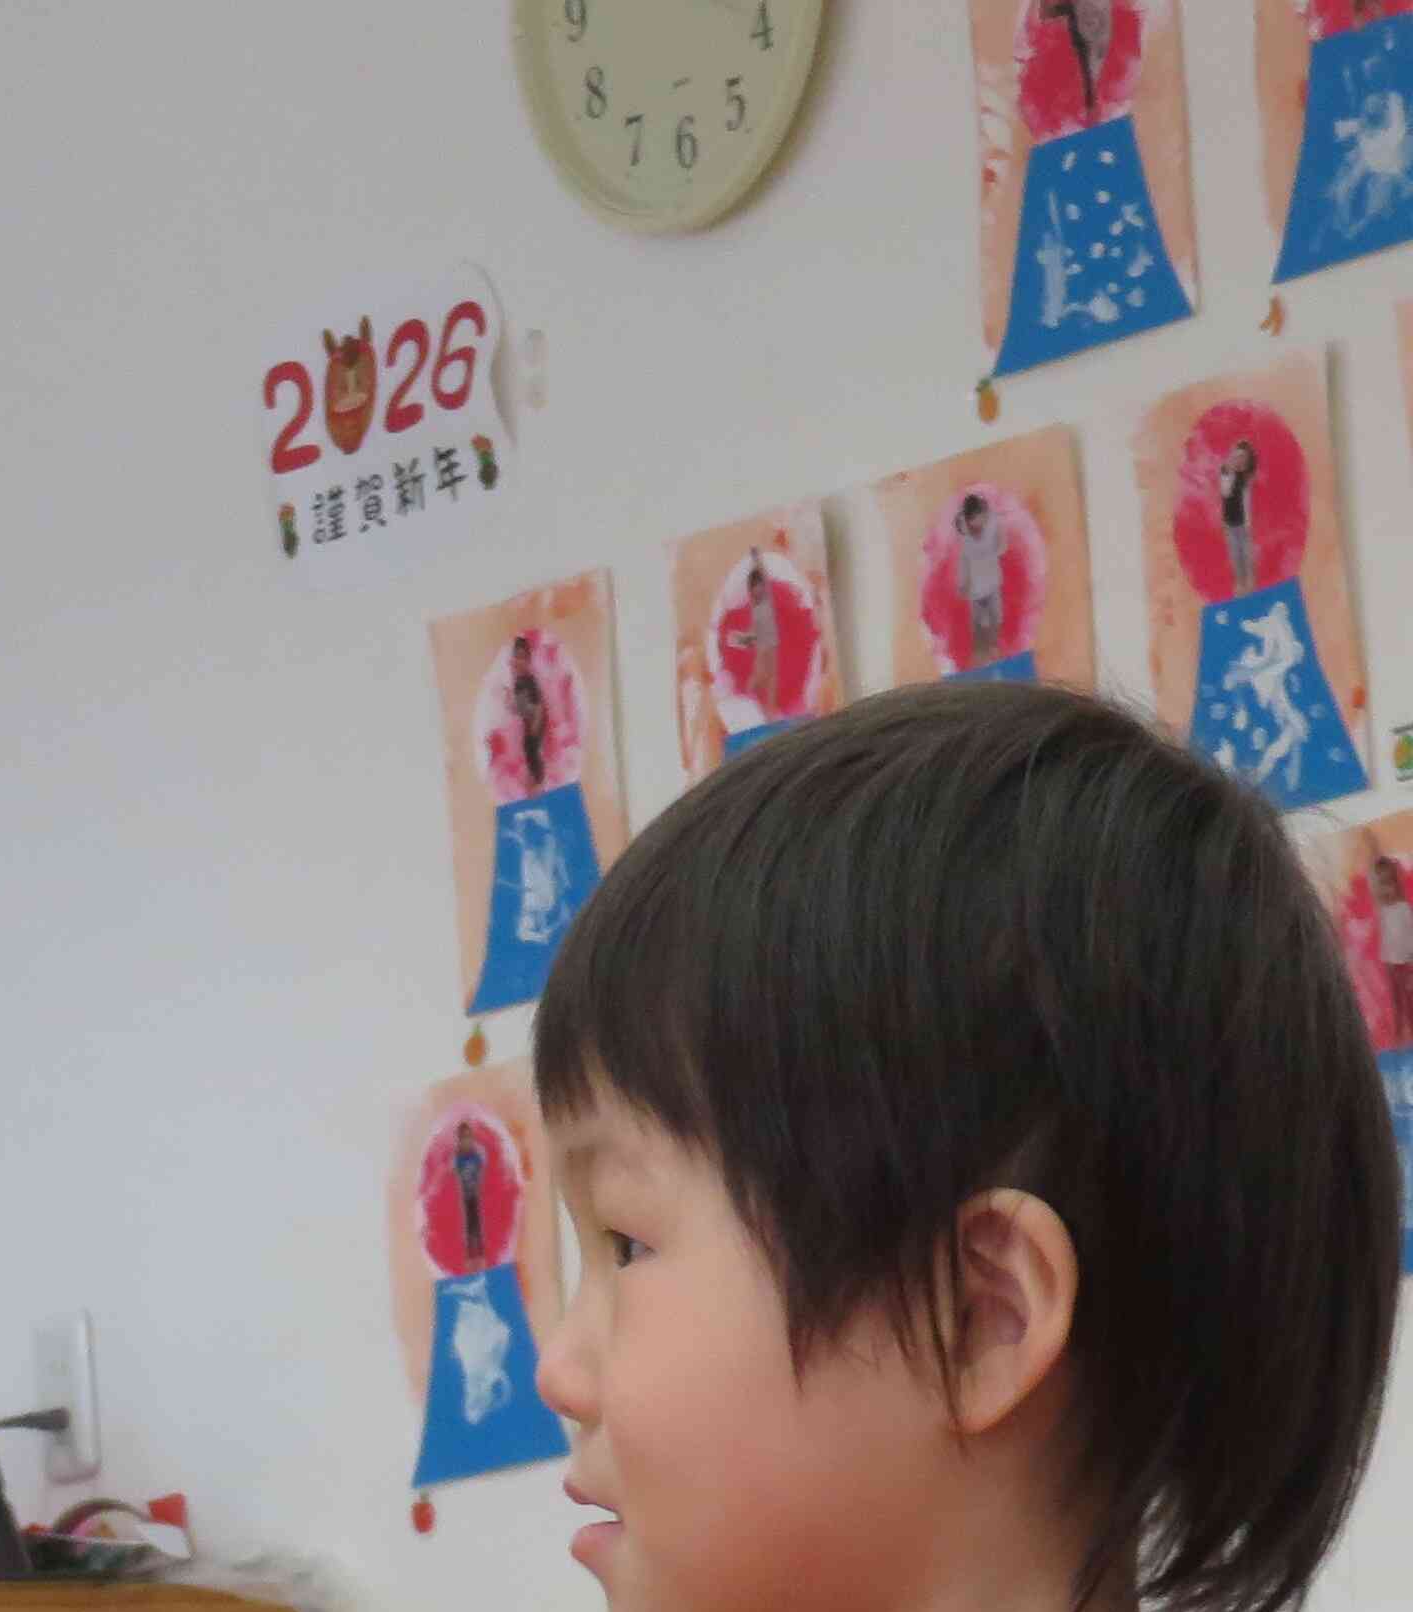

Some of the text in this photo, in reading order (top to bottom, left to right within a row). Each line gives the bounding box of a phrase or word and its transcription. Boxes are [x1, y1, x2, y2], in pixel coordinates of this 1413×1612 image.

[564, 0, 588, 42] 9
[749, 0, 774, 50] 4
[584, 65, 607, 119] 8
[724, 76, 746, 131] 5
[624, 113, 645, 167] 7
[675, 114, 699, 170] 6
[310, 446, 467, 545] 謹賀新年
